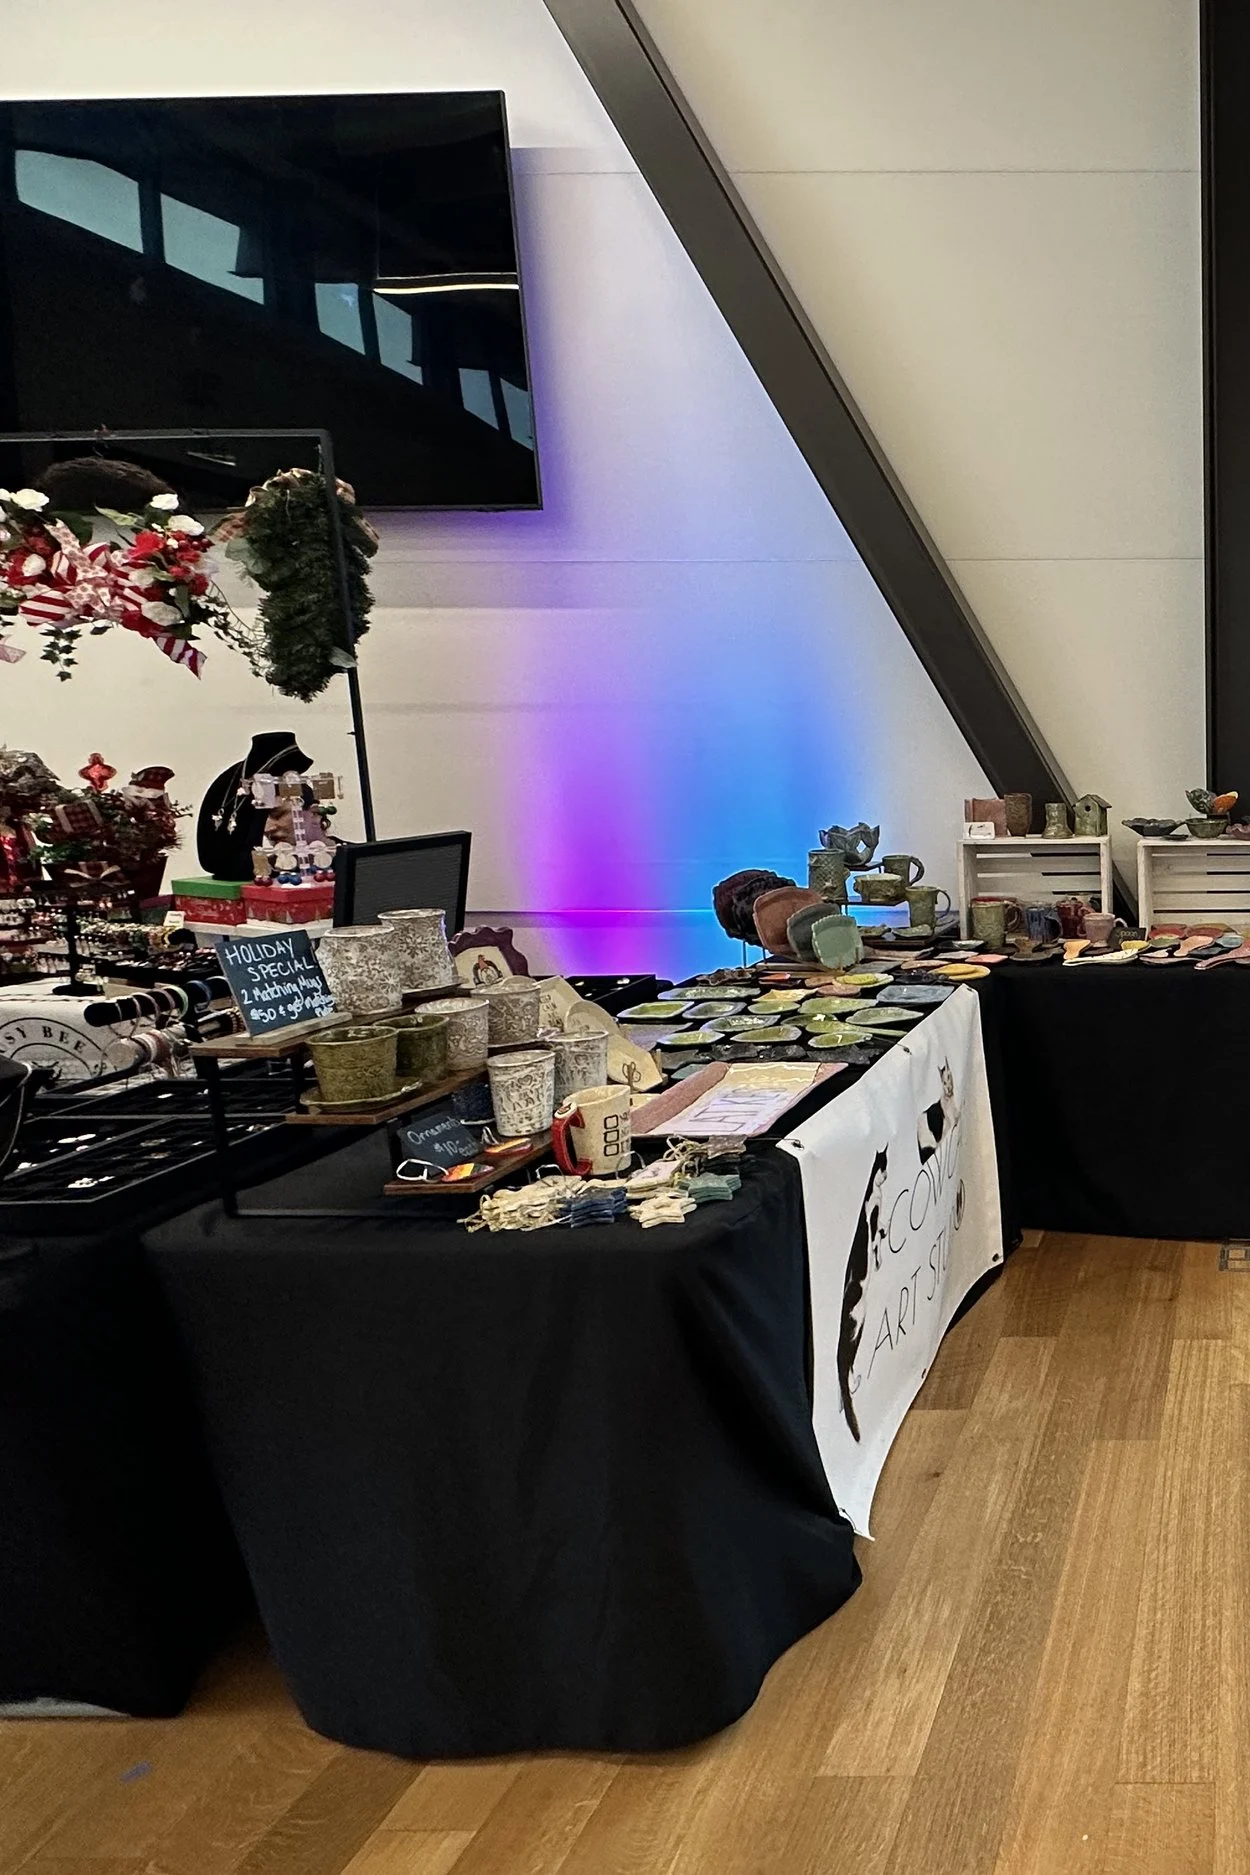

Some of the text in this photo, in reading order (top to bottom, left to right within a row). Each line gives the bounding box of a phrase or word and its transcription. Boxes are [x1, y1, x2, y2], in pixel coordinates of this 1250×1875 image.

[225, 938, 295, 965] HOLIDAY
[247, 957, 315, 982] SPECIAL
[241, 989, 253, 1005] 2
[249, 1007, 277, 1023] $50
[42, 1025, 86, 1054] BEE
[866, 1266, 922, 1380] ART
